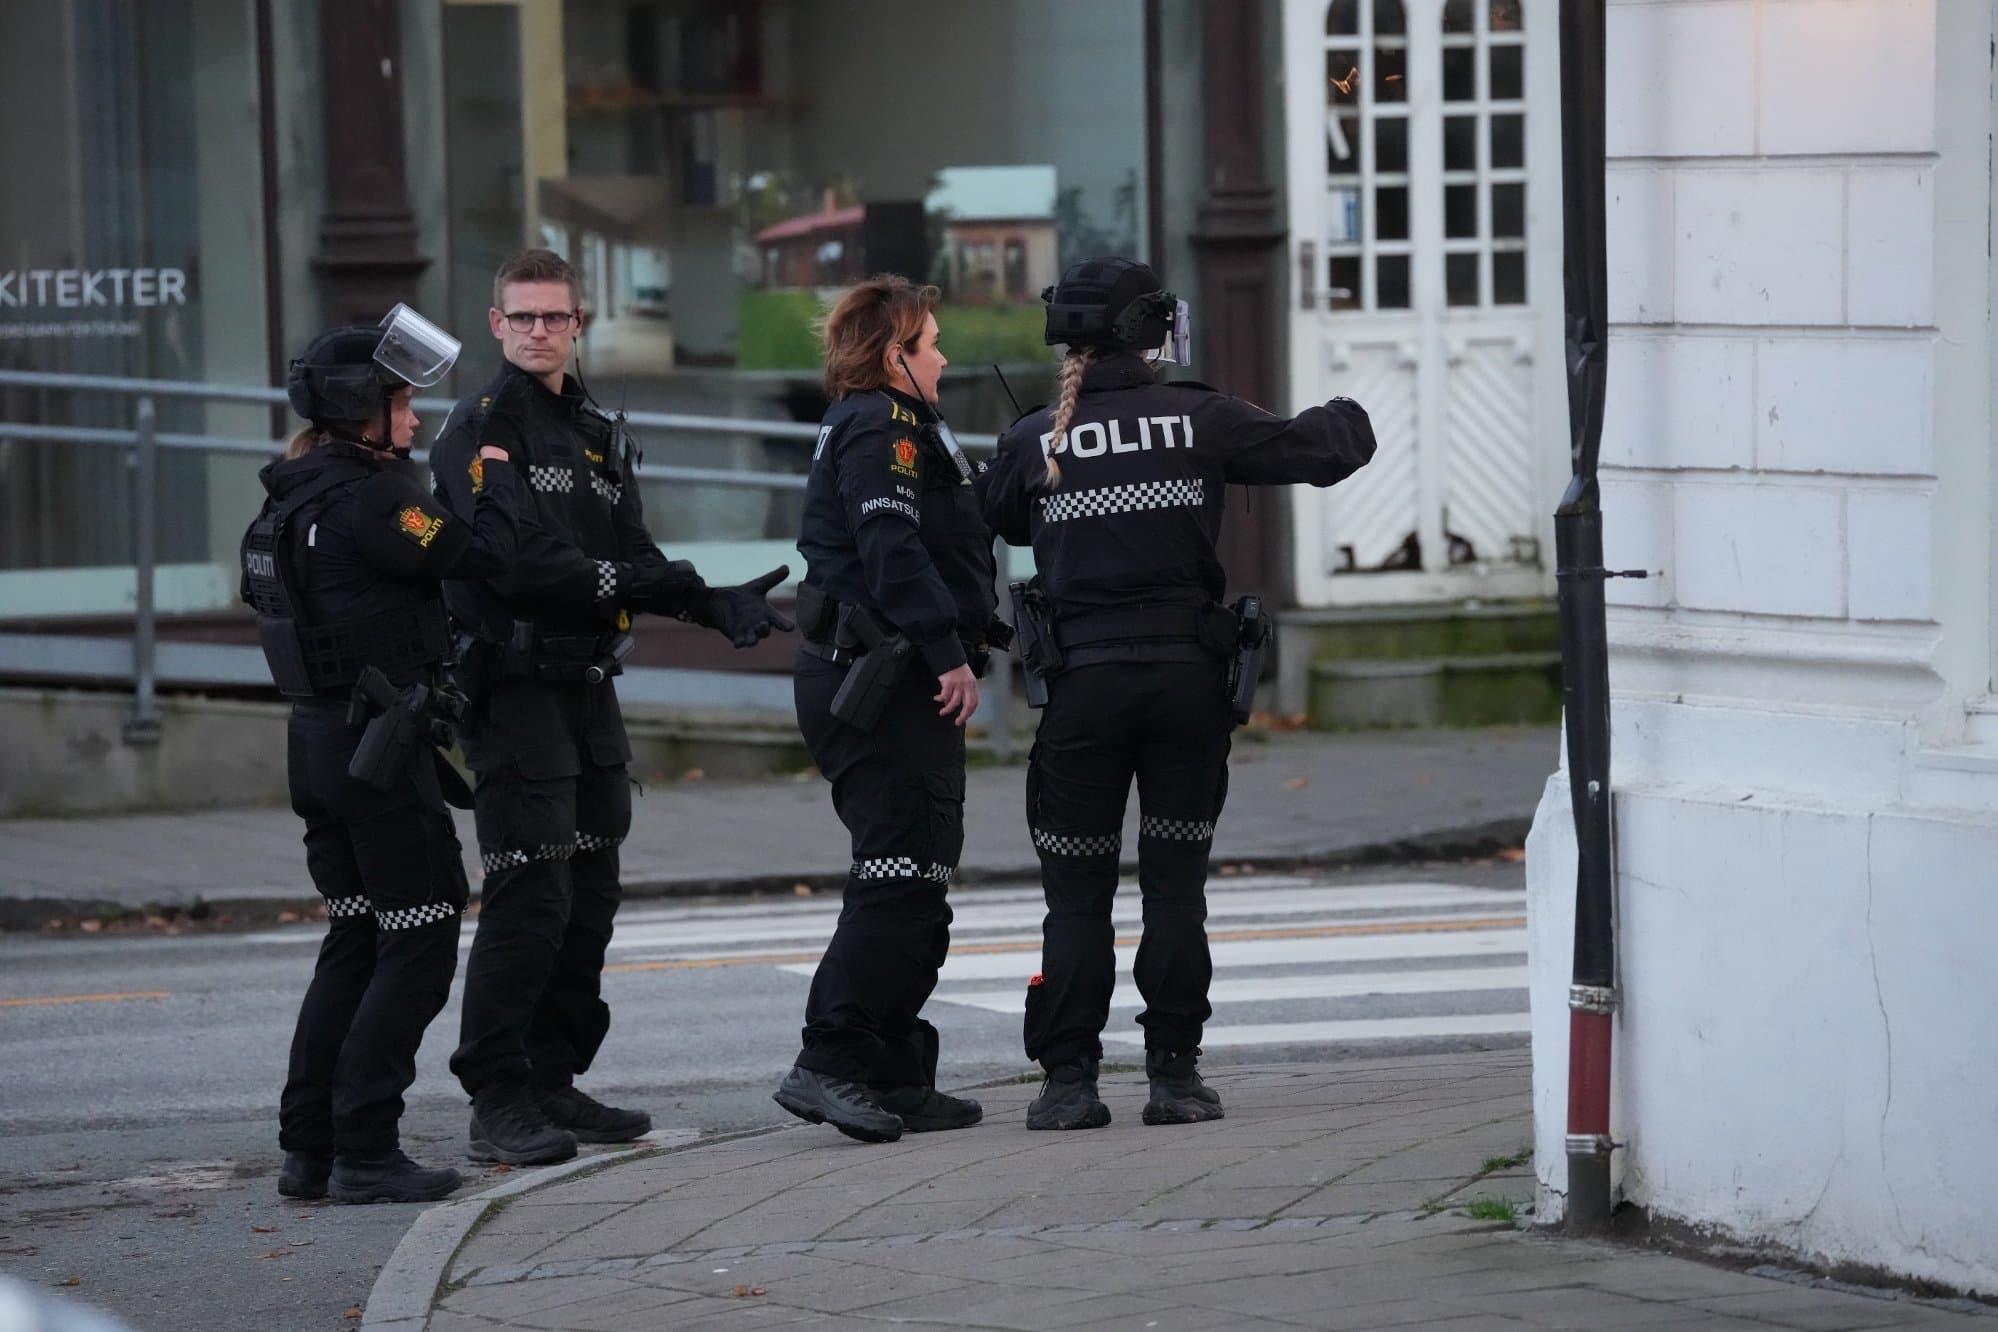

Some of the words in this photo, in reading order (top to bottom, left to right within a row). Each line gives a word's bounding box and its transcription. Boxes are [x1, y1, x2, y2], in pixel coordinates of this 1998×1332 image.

[1040, 415, 1193, 465] POLITI
[891, 464, 918, 479] POLITI
[896, 485, 915, 500] M-05
[420, 518, 444, 547] POLITI
[247, 552, 275, 577] POLITI
